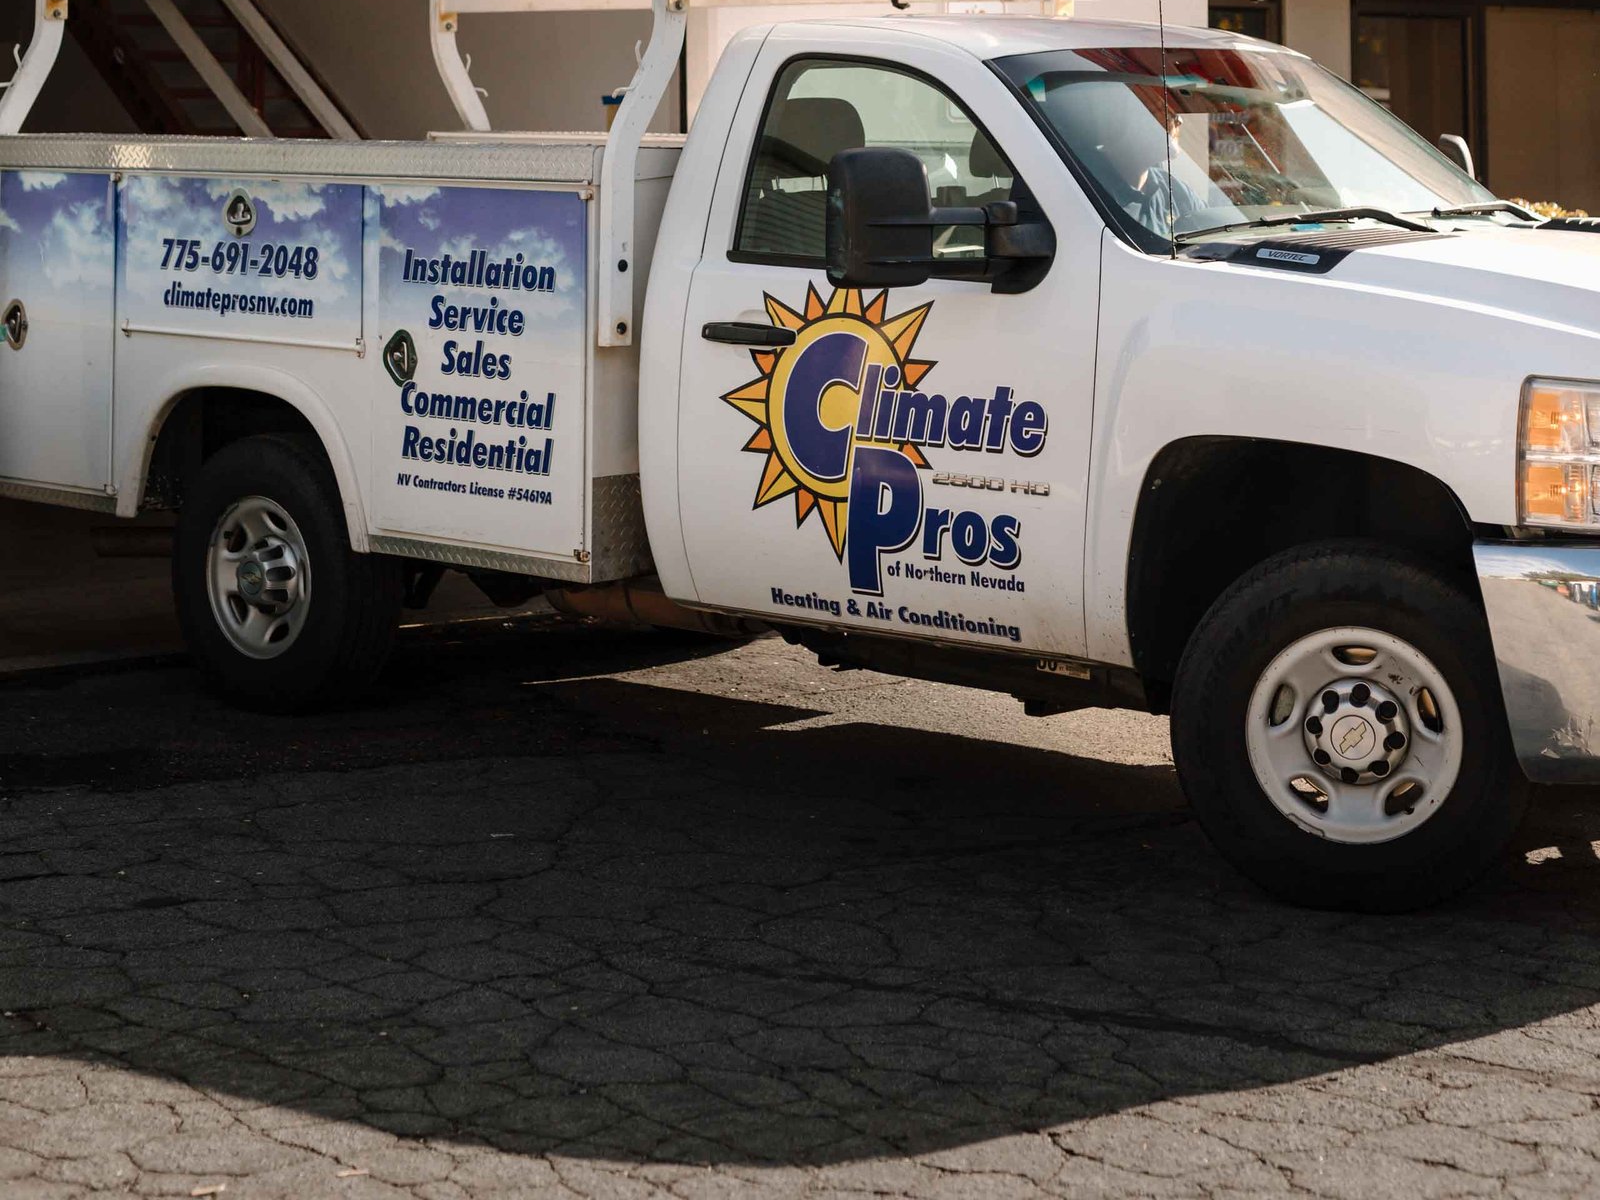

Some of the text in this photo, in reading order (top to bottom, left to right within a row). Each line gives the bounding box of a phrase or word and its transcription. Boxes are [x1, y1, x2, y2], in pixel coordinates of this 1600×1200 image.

[160, 238, 320, 281] 775-691-2048
[402, 249, 556, 293] Installation
[1268, 250, 1309, 261] VORTEC
[163, 281, 315, 319] climateprosnv.com
[428, 296, 526, 336] Service
[440, 341, 512, 380] Sales
[400, 381, 556, 431] Commercial
[783, 332, 1048, 480] Climate
[402, 426, 554, 476] Residential
[397, 472, 553, 505] NV Contractors License #54619A
[933, 471, 1004, 491] 2500
[847, 446, 1022, 597] Pros
[887, 562, 1024, 593] of Northern Nevada
[771, 587, 1021, 641] Heating & Air Conditioning
